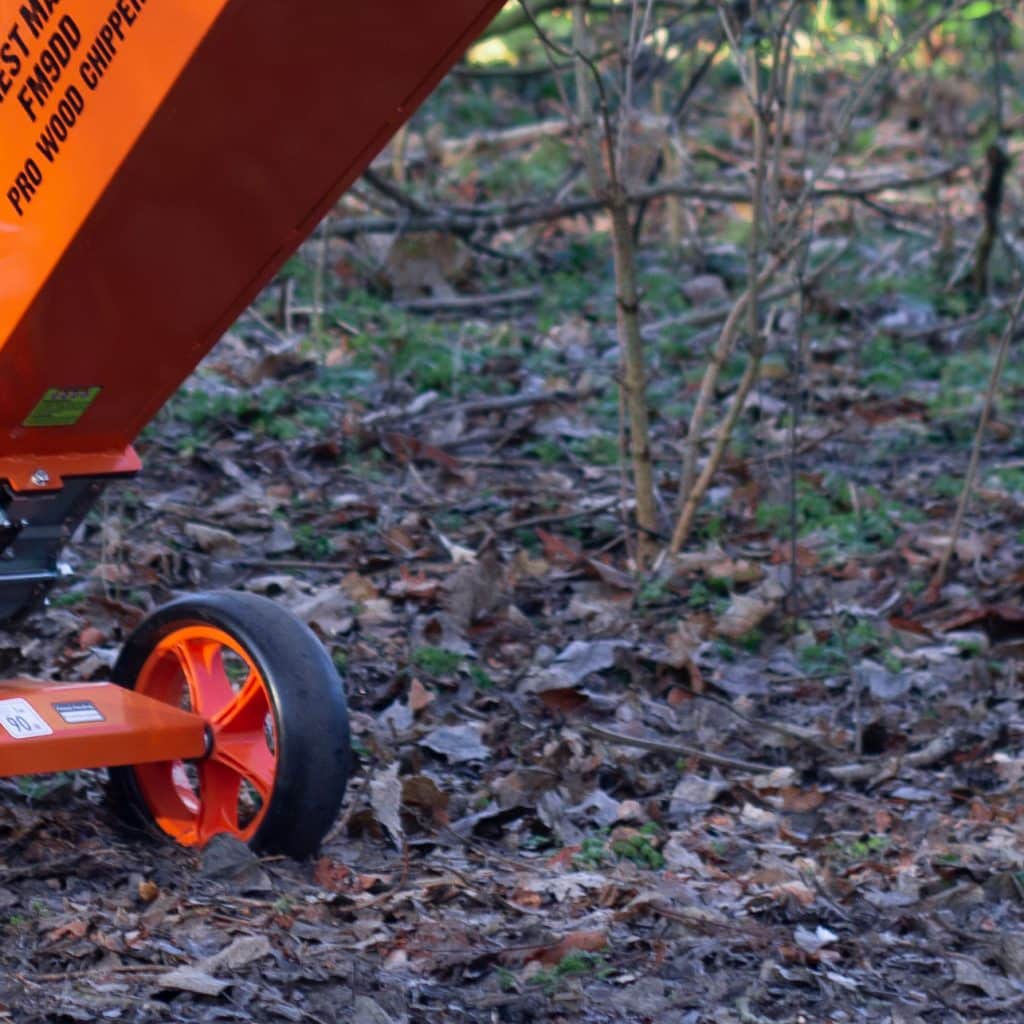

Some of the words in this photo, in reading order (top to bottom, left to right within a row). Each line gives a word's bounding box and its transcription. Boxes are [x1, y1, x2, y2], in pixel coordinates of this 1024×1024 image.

[17, 14, 81, 122] FM9DD
[7, 158, 43, 216] PRO
[35, 84, 85, 162] WOOD
[5, 715, 32, 732] 90
